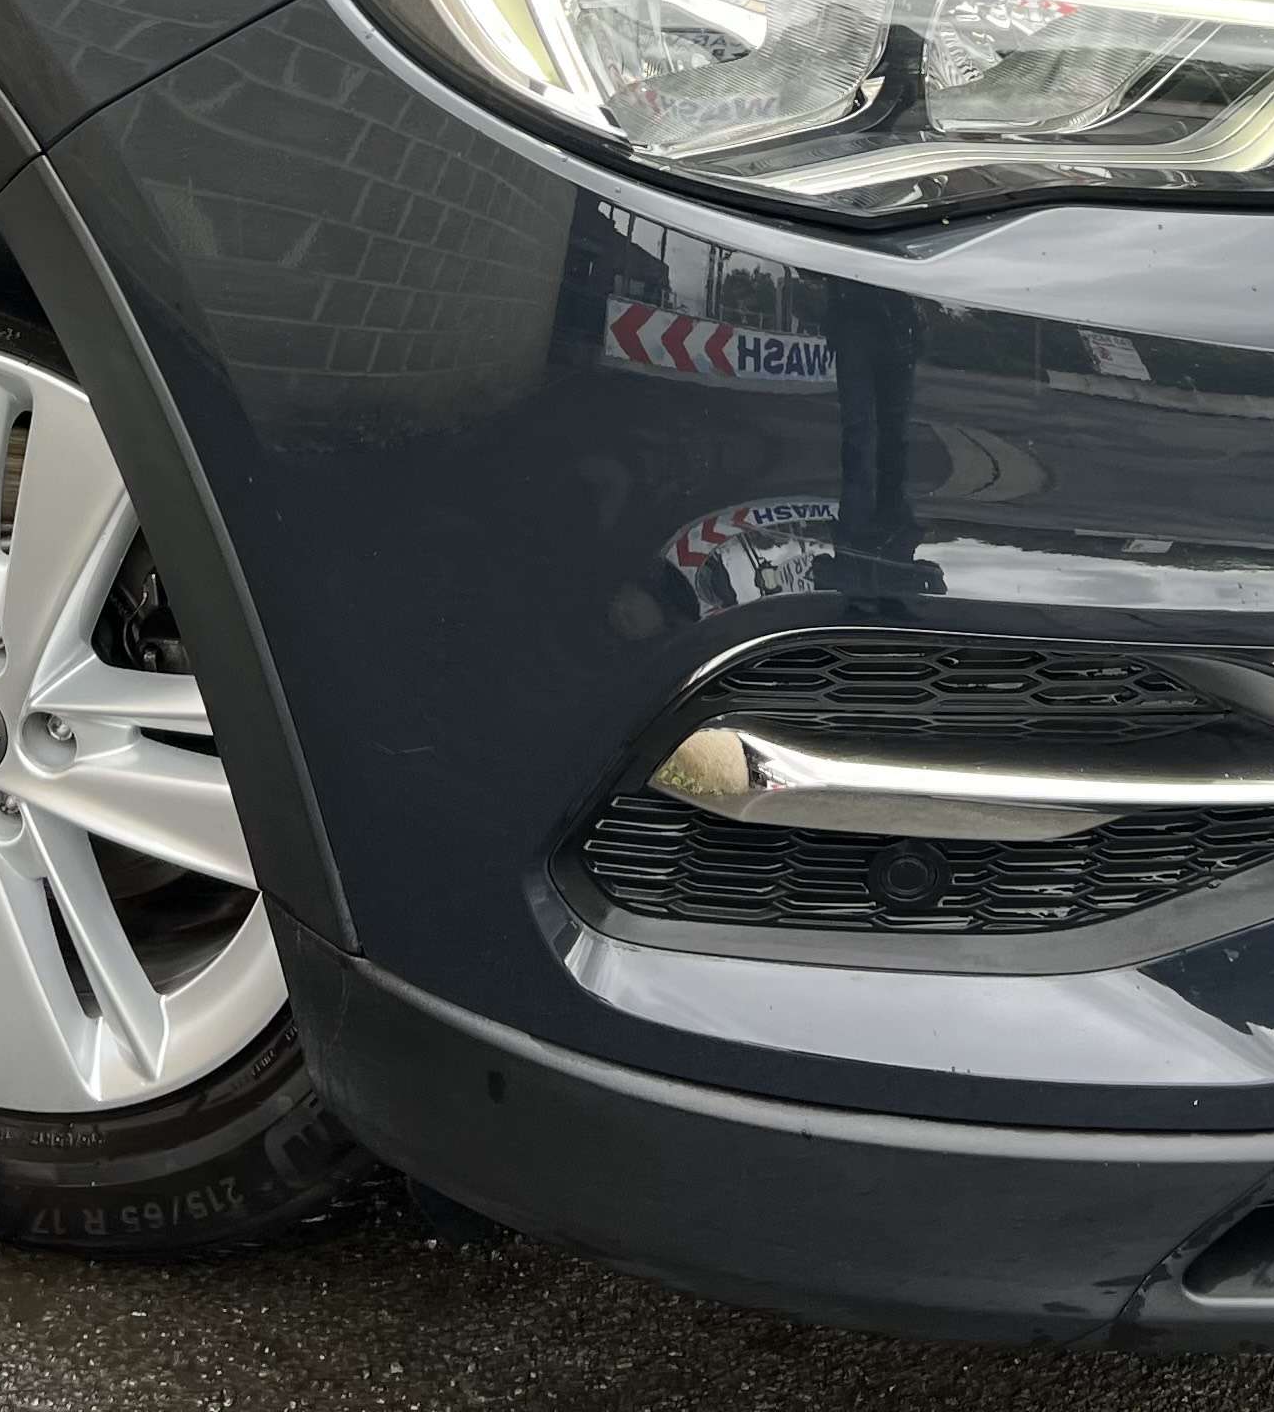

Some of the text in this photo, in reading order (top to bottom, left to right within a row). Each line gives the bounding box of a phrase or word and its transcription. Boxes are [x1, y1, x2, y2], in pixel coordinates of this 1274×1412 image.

[31, 1176, 245, 1236] 215/65 R 17
